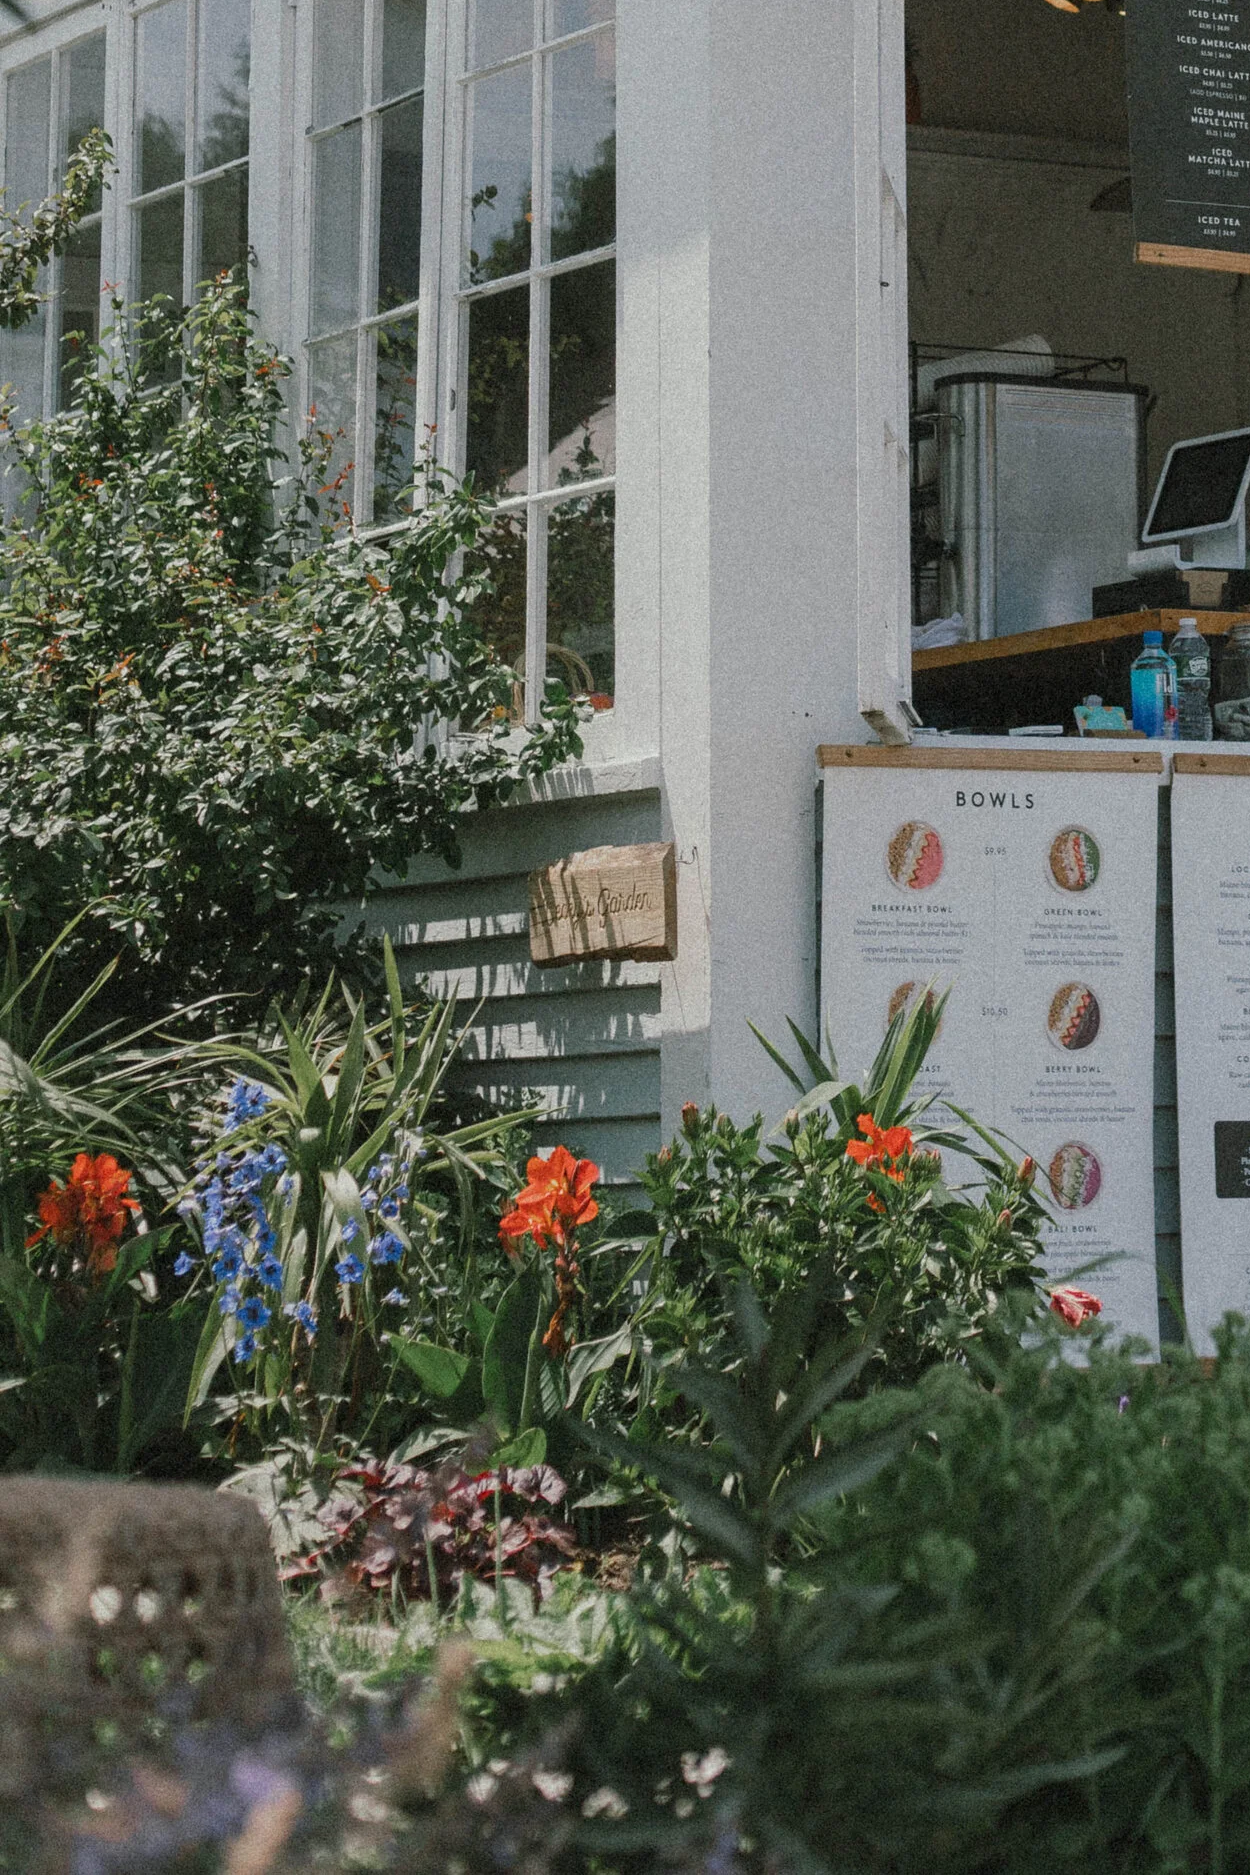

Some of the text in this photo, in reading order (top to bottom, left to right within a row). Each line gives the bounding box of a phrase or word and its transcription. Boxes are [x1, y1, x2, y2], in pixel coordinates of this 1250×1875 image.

[1188, 9, 1239, 23] ICED LATTE
[1177, 35, 1198, 45] ICED
[1179, 65, 1200, 75] ICED
[1203, 68, 1225, 77] CHAI
[1193, 107, 1245, 120] ICED MAINE
[1191, 116, 1249, 130] MAPLE LATTE
[1212, 148, 1233, 157] ICED
[1188, 155, 1227, 165] MATCHA
[1198, 216, 1241, 227] ICED TEA
[956, 791, 1034, 809] BOWLS
[984, 847, 1007, 856] $9.95
[598, 883, 652, 928] Garden
[871, 904, 952, 913] BREAKFAST BOWL
[1044, 908, 1073, 916] GREEN
[982, 1008, 1008, 1017] $10.50
[1045, 1065, 1102, 1074] BERRY BOWL
